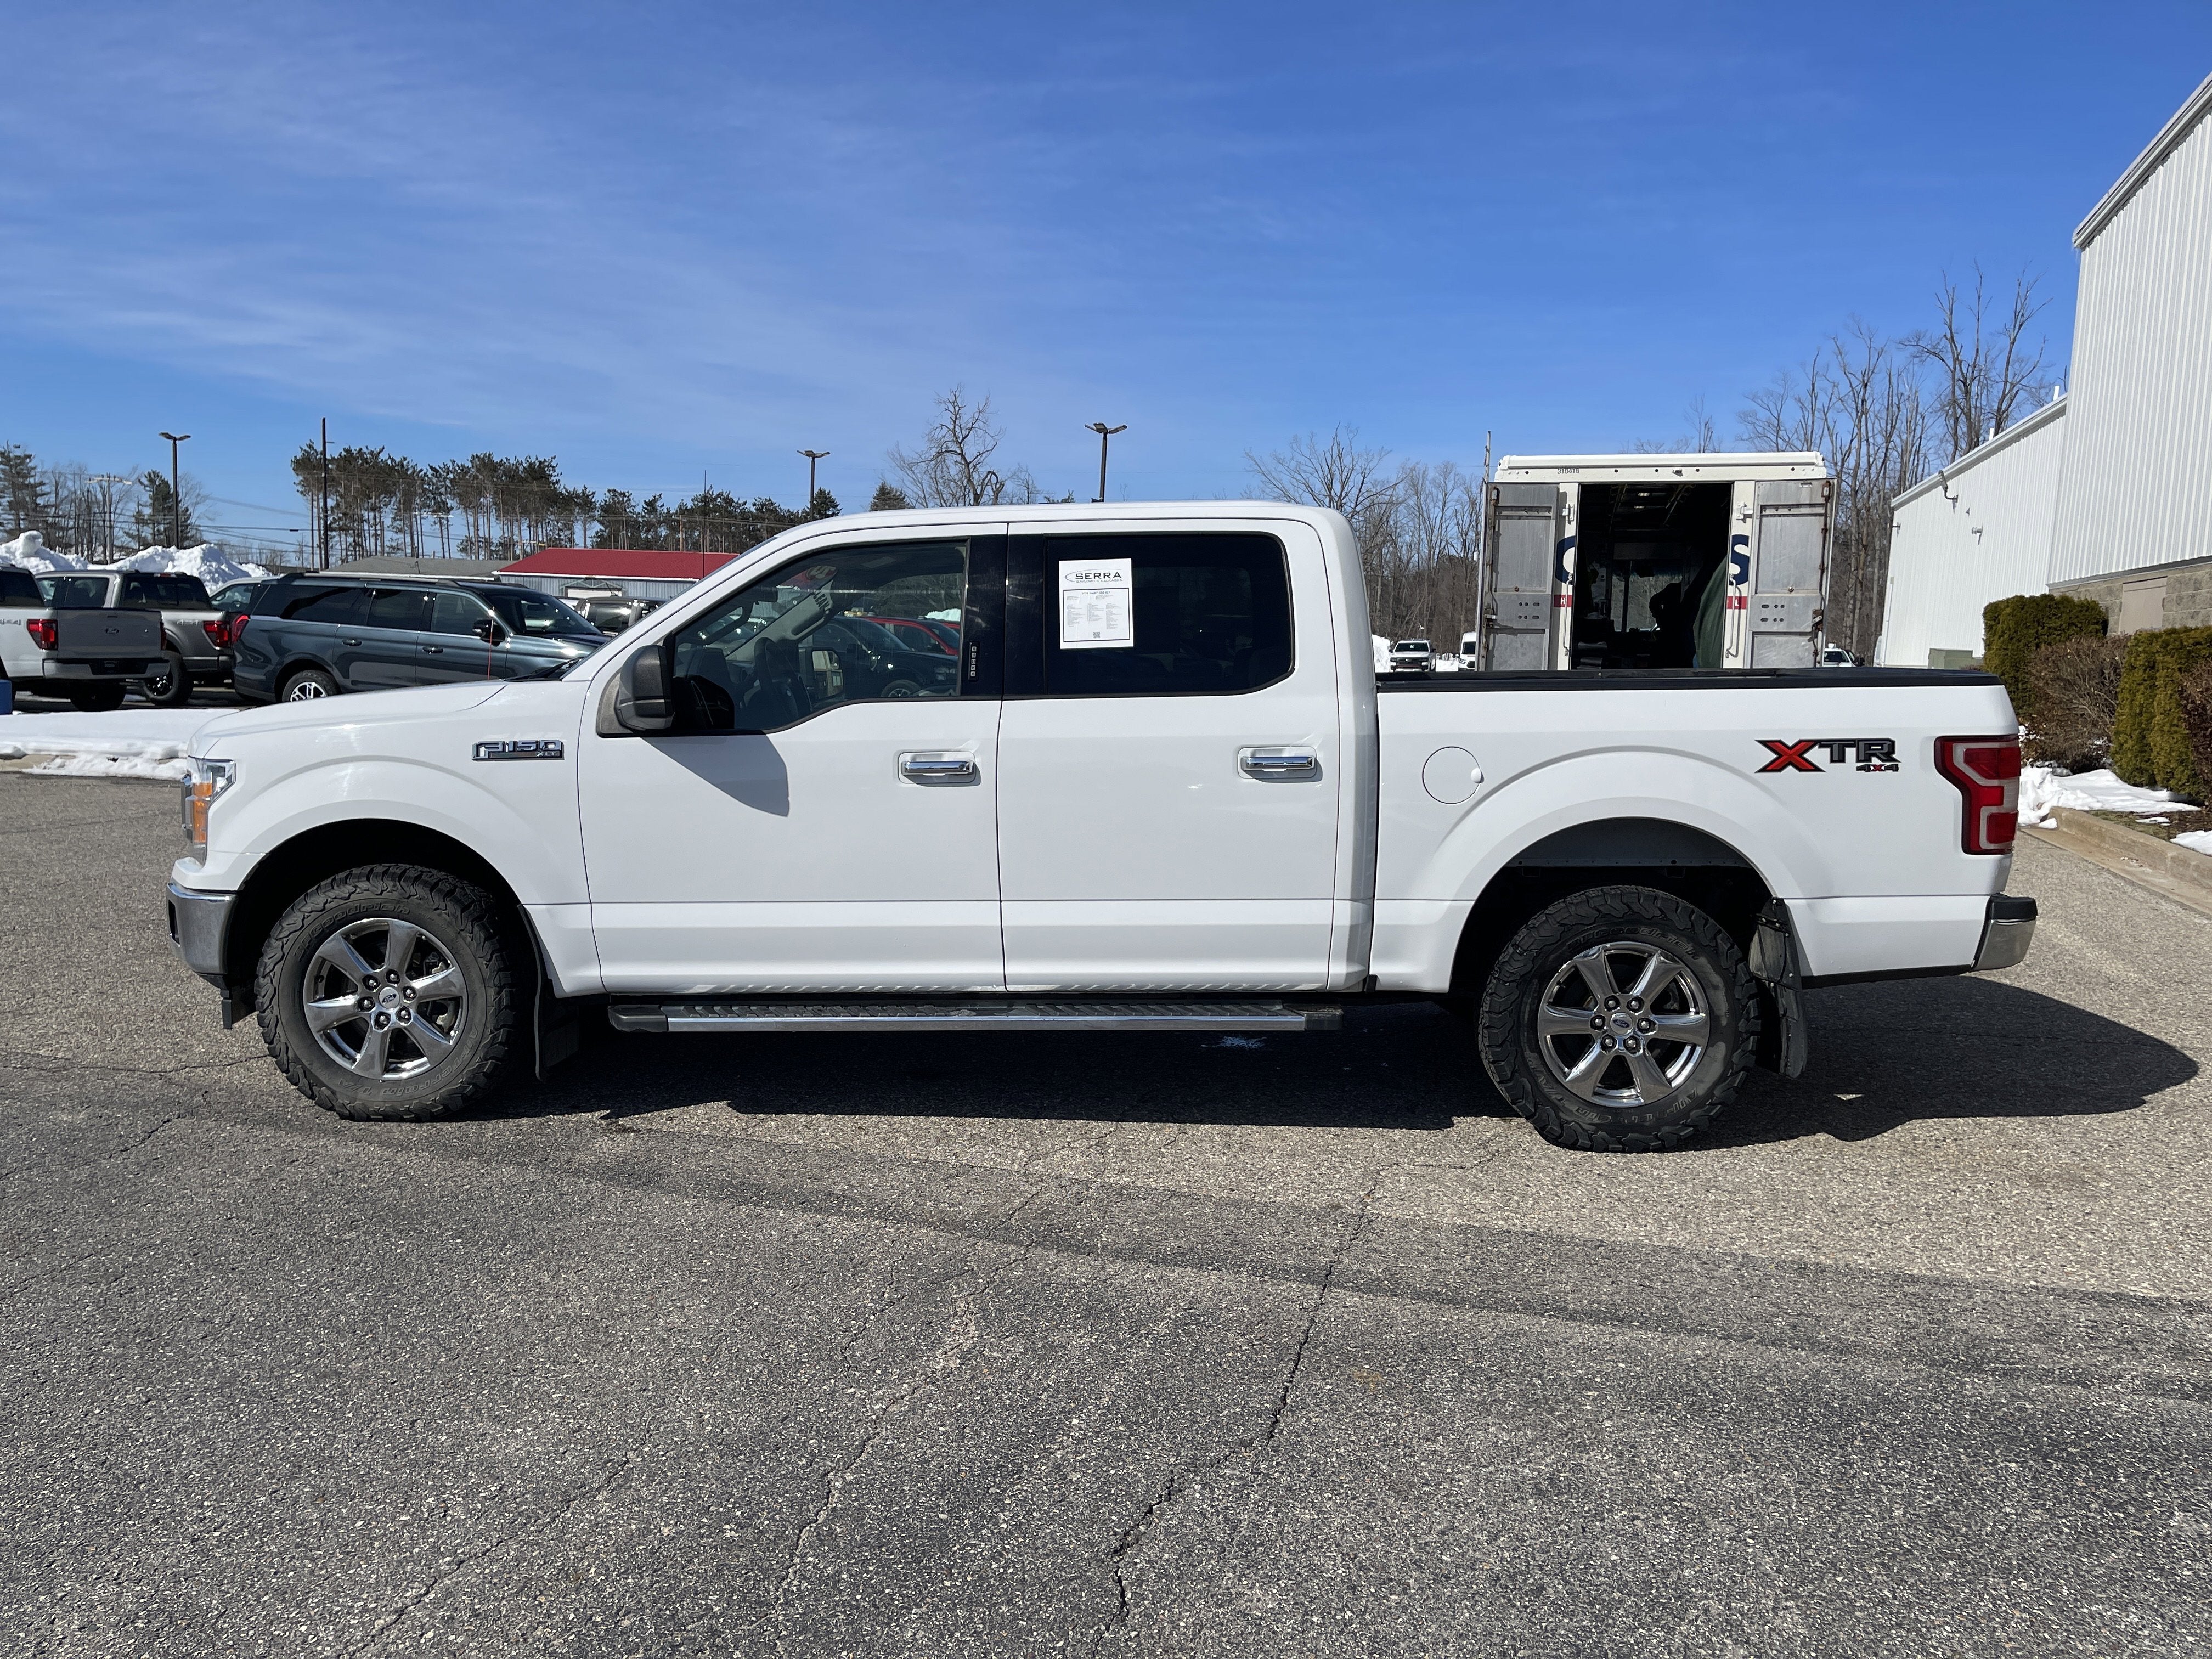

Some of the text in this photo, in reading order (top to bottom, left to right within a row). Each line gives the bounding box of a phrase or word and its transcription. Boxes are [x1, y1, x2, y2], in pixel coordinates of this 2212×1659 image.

[1075, 572, 1122, 580] SERRA
[1754, 738, 1901, 774] XTR
[293, 902, 410, 962] BFGoodrich
